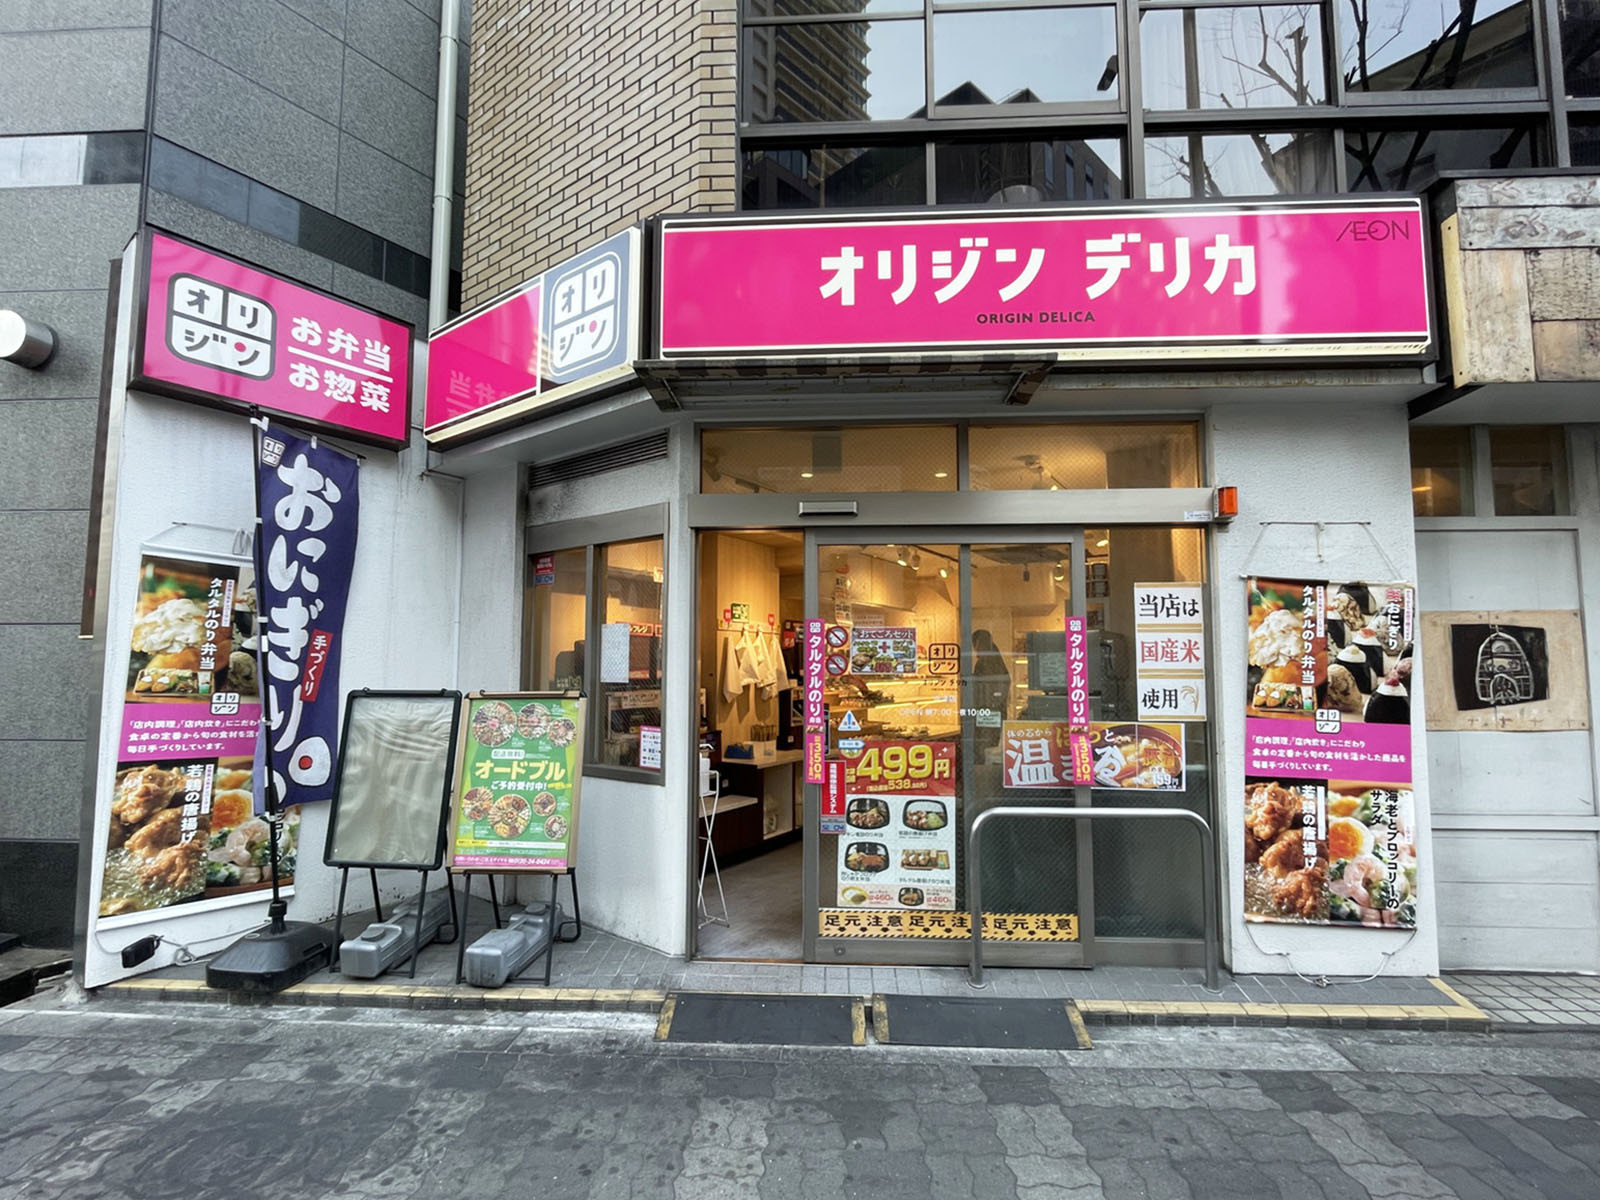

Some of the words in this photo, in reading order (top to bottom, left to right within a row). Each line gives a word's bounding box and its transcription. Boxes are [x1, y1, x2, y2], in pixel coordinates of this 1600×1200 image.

[819, 238, 1046, 306] オリジン
[1085, 233, 1258, 301] デリカ
[976, 312, 1034, 325] ORIGIN
[1039, 310, 1096, 324] DELICA
[291, 317, 391, 372] お弁当
[289, 362, 391, 414] お惣菜
[200, 577, 223, 670] タルタルのり弁当
[266, 453, 342, 753] おにぎり
[1139, 593, 1200, 618] 当店は
[1140, 638, 1201, 663] 国産米
[1302, 585, 1316, 685] タルタルのり弁当
[305, 635, 328, 697] 手づくり
[1142, 688, 1179, 710] 使用
[475, 759, 566, 781] オードブル
[1371, 789, 1383, 826] サラダ
[1384, 789, 1400, 910] 海老とブロッコリーの
[824, 914, 904, 928] 足元注意
[993, 917, 1073, 931] 足元注意
